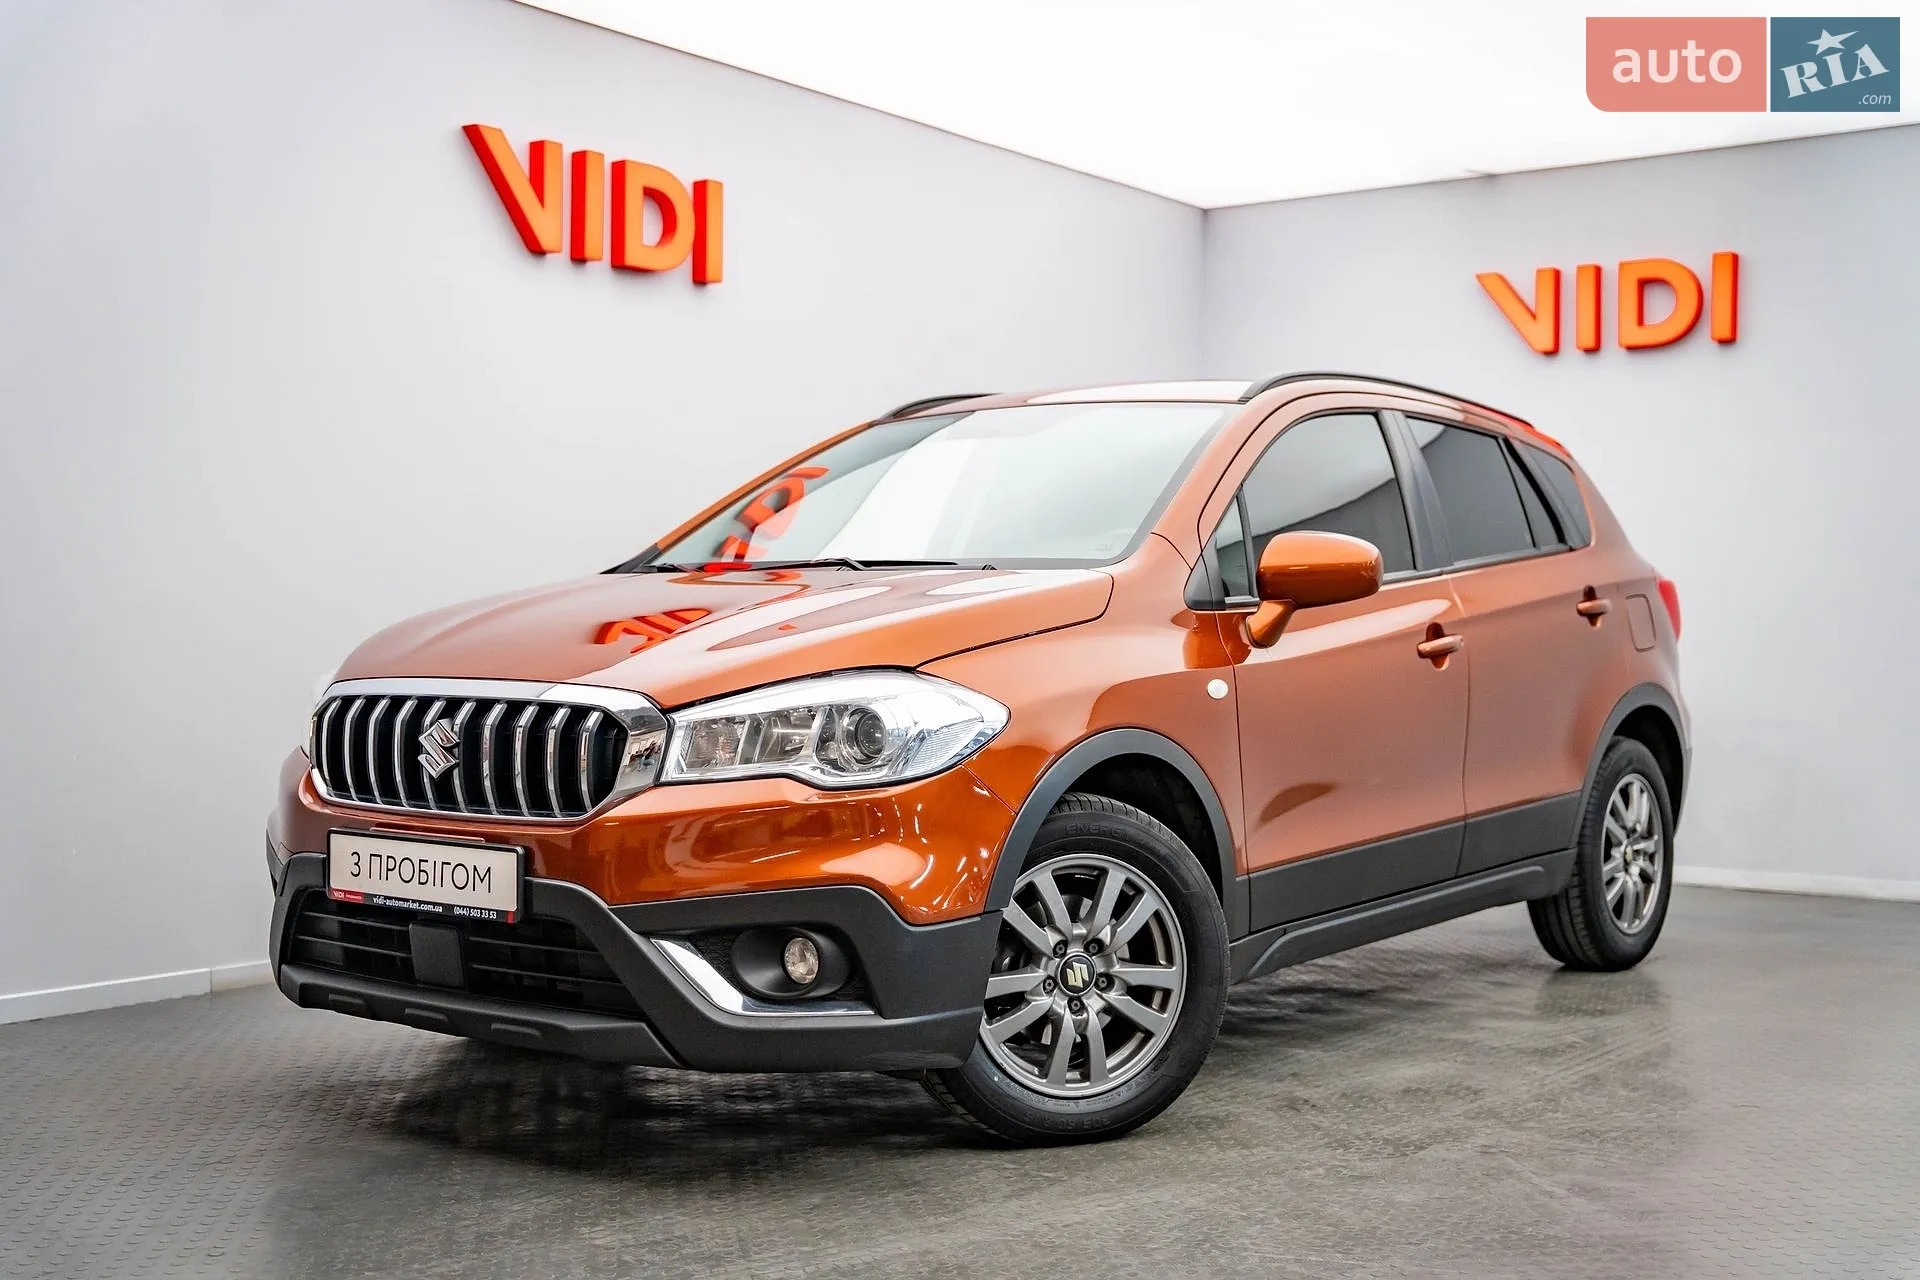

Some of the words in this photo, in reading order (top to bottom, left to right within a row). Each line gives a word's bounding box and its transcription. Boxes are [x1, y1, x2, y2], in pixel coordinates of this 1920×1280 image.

[462, 124, 723, 285] VIDI
[1475, 251, 1739, 354] VIDI
[368, 853, 492, 893] ПРОБІГОМ
[372, 896, 443, 913] vidi-automarket.com.ua
[470, 908, 481, 918] 503
[481, 909, 489, 918] 33
[489, 911, 497, 919] 53
